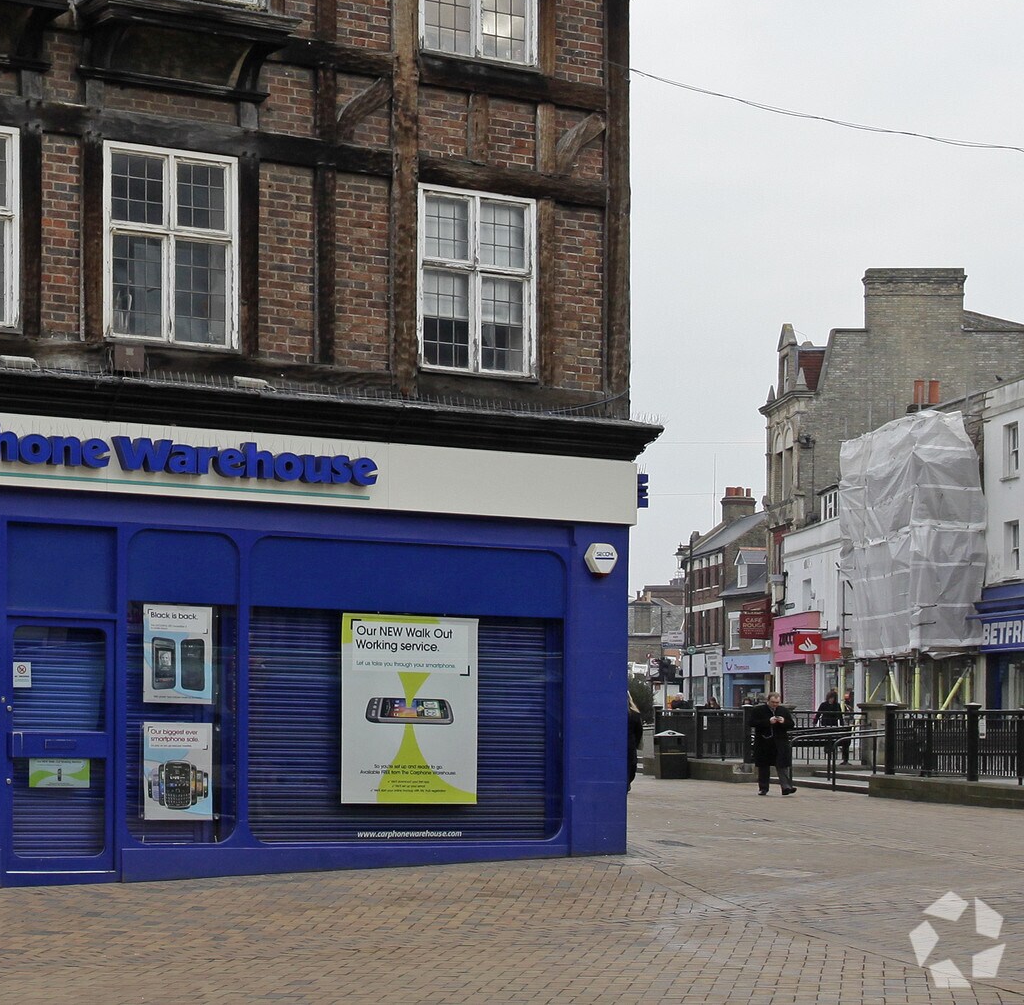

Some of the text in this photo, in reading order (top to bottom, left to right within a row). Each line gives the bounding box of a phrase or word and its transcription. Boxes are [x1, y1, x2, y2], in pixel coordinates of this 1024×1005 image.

[111, 435, 378, 487] Warehouse
[150, 611, 170, 619] Black
[178, 612, 199, 620] back.
[356, 625, 453, 639] Our NEW Walk Out
[355, 639, 440, 652] Working service.
[162, 728, 184, 736] biggest
[357, 830, 462, 839] www.carphonewarehouse.com
